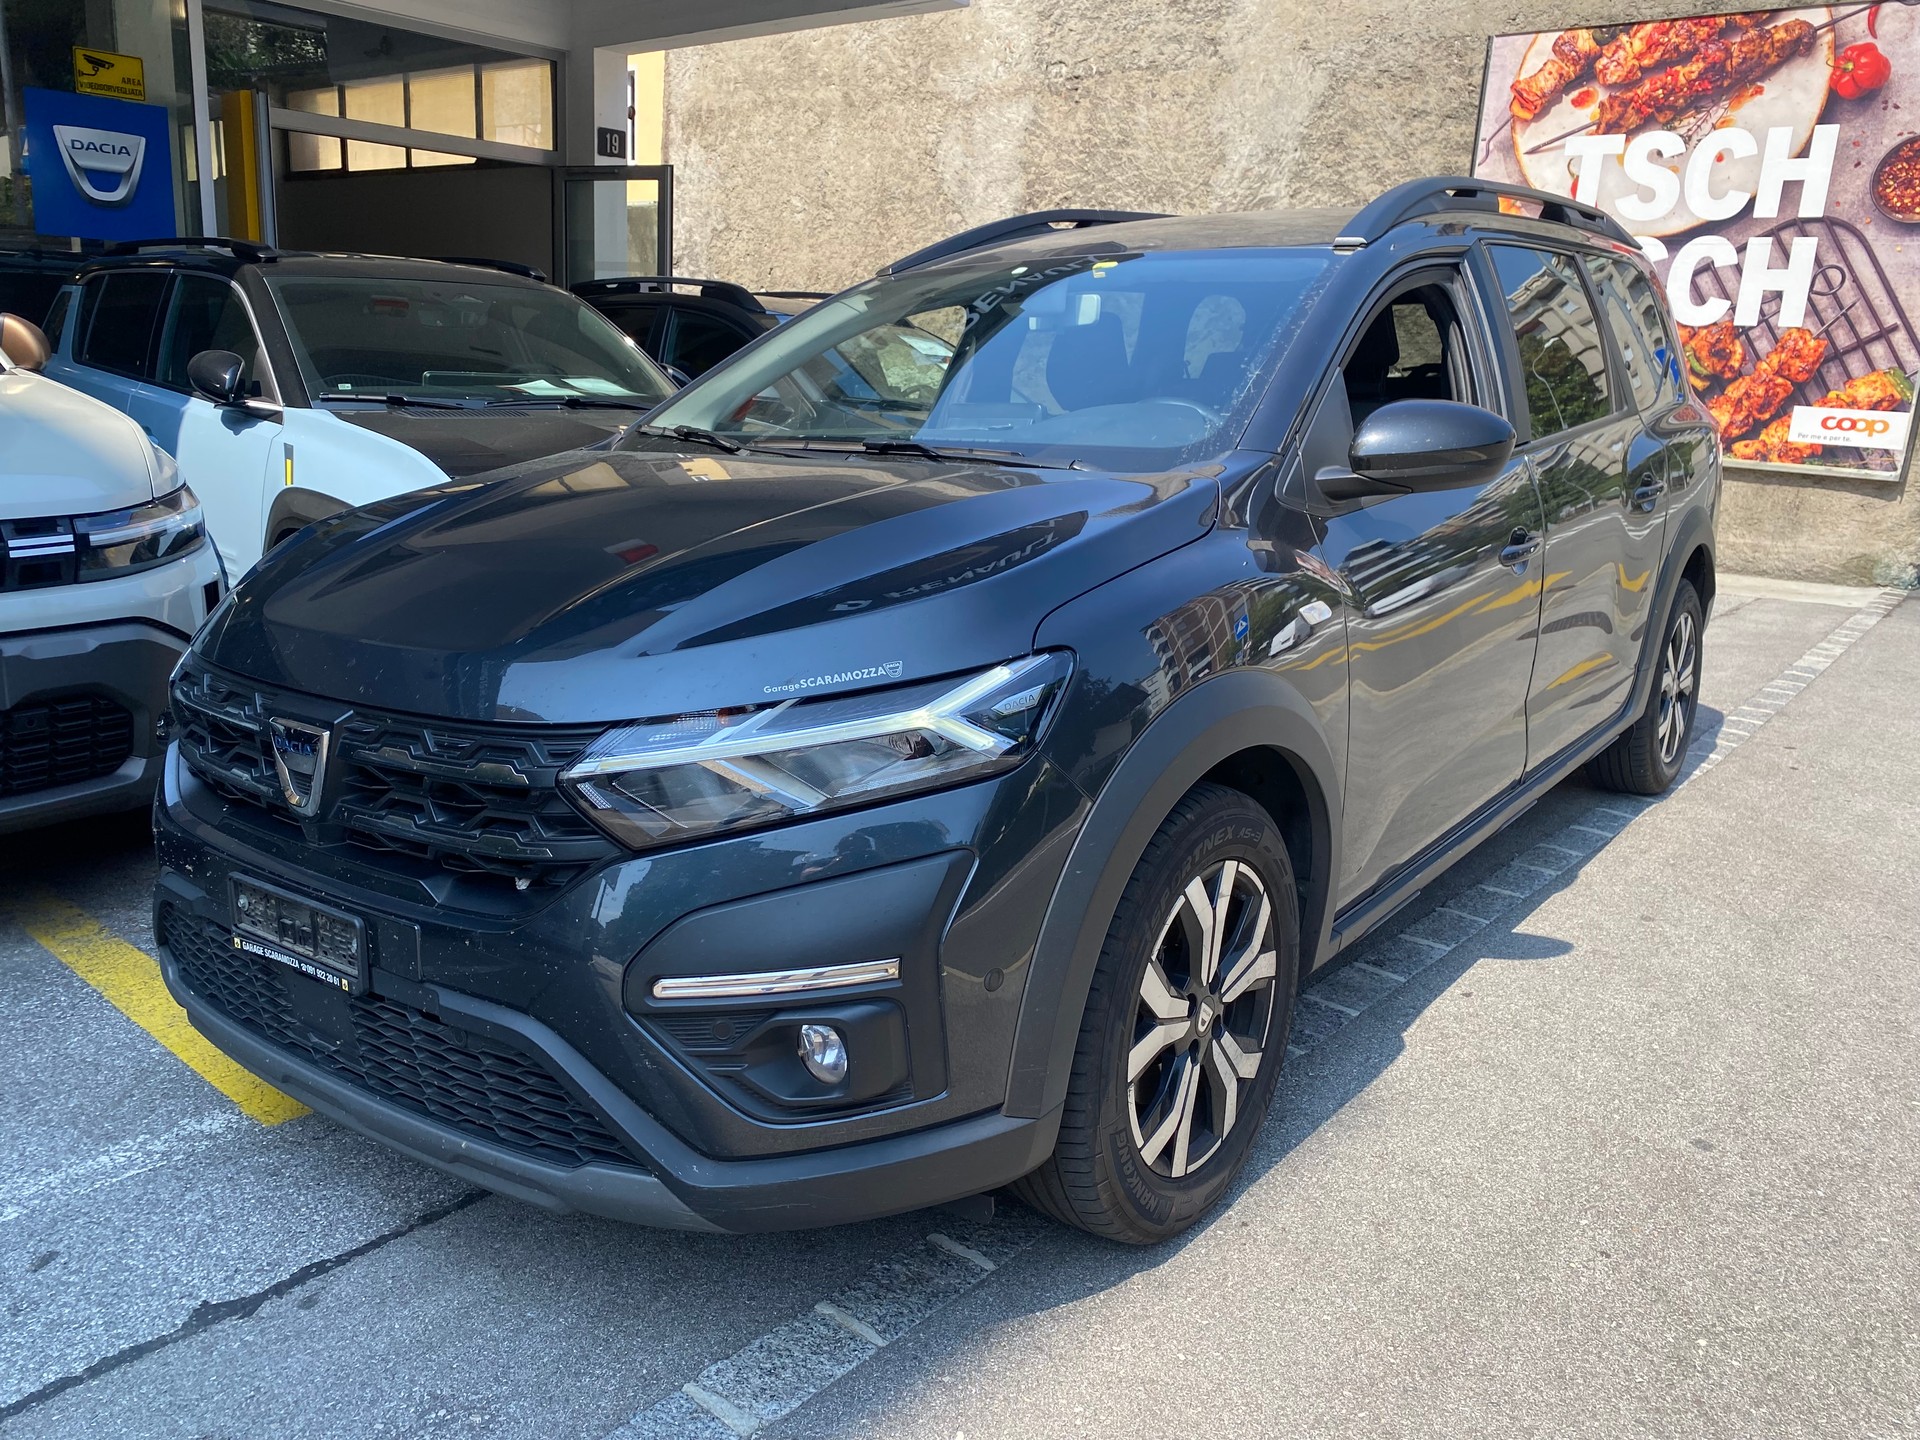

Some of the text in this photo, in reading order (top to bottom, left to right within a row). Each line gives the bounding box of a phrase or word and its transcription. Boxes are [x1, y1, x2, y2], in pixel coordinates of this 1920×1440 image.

[121, 77, 142, 87] AREA
[70, 139, 131, 157] DACIA
[606, 132, 619, 154] 19
[1564, 123, 1841, 221] TSCH
[1821, 415, 1890, 437] coop
[1004, 694, 1035, 711] DACIA
[274, 735, 313, 756] DACIA
[242, 941, 264, 956] GARAGE
[264, 948, 300, 969] SCARAMOZZA
[316, 968, 326, 980] 922
[326, 973, 334, 984] 20
[1116, 1131, 1161, 1213] NANKANG
